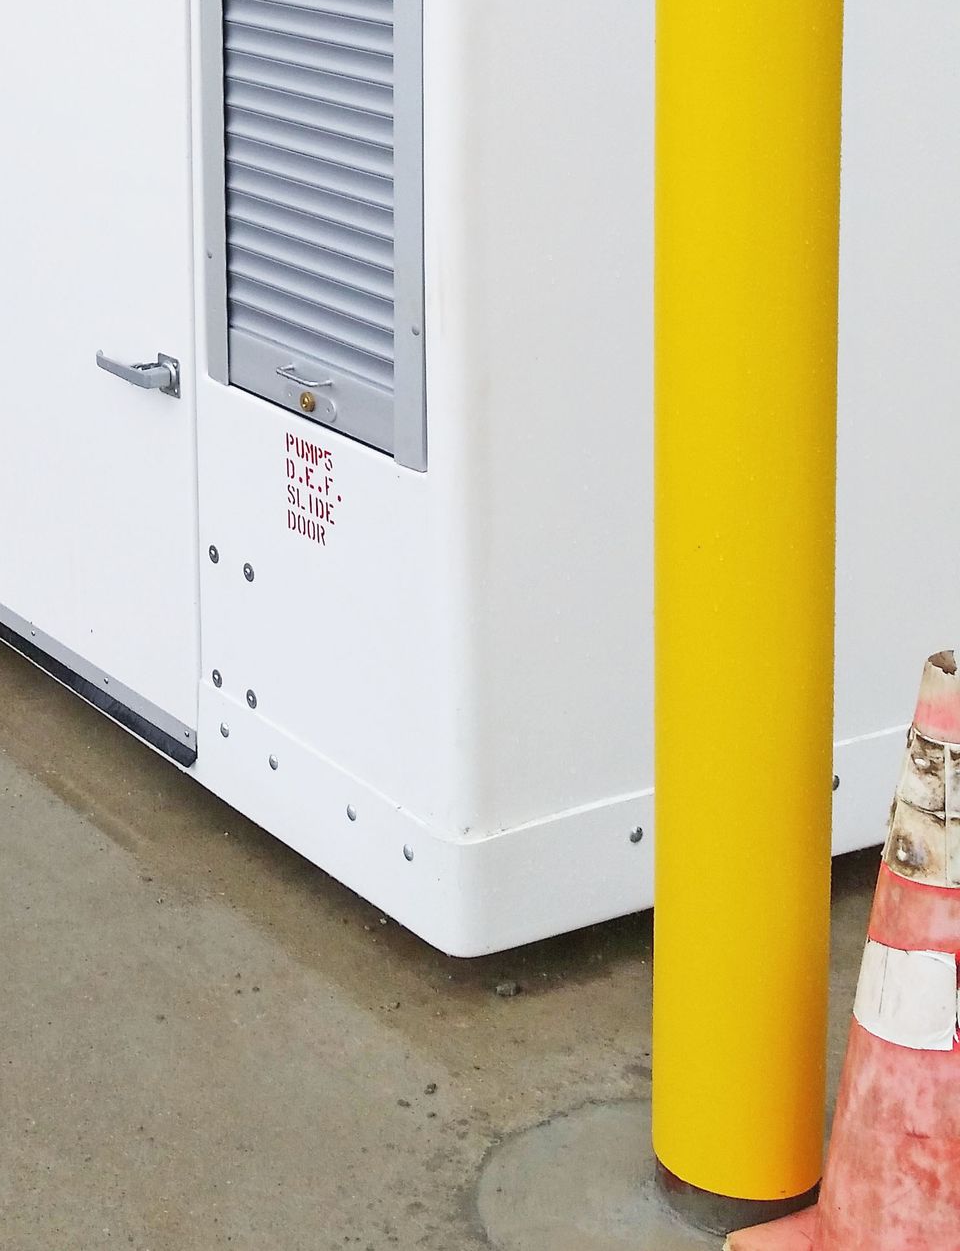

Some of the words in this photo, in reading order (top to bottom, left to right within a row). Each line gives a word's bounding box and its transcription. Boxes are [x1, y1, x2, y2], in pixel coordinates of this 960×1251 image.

[286, 457, 342, 503] D.E.F.
[287, 484, 335, 525] SLIDE
[287, 509, 326, 546] DOOR
